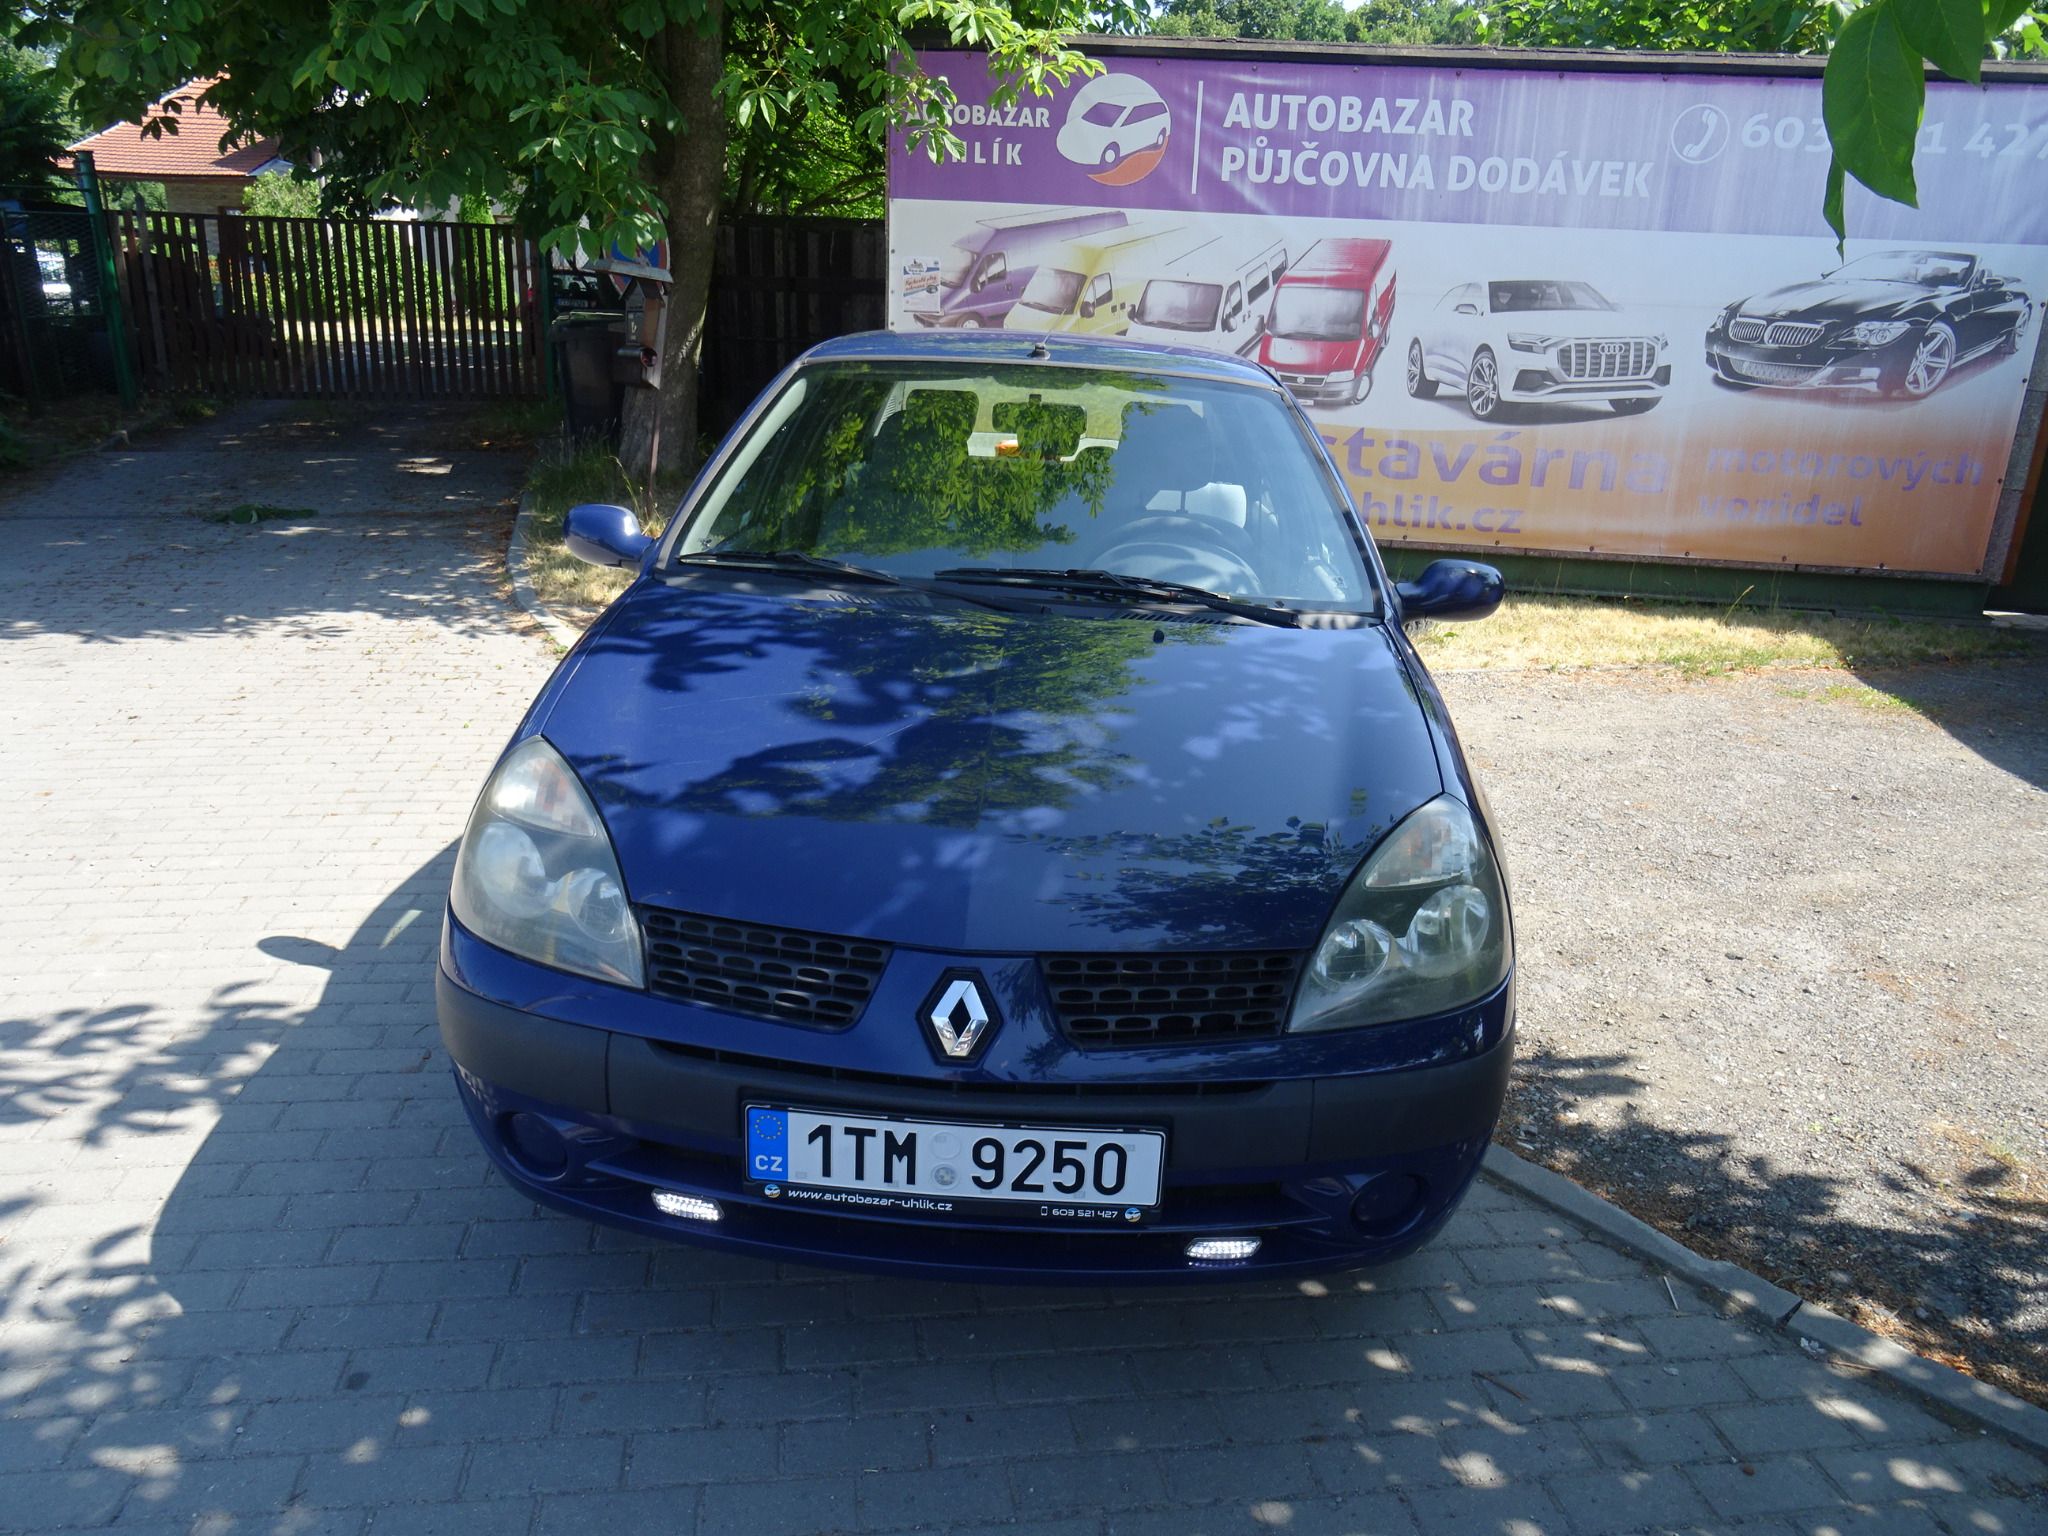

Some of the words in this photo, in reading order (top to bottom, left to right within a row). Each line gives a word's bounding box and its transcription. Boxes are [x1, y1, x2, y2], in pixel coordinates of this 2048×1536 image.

[1222, 92, 1474, 137] AUTOBAZAR
[1221, 135, 1436, 190] PŮJČOVNA
[1447, 150, 1655, 198] DODÁVEK
[1320, 426, 1668, 494] tavárna
[1705, 447, 1985, 491] motorových
[1697, 491, 1863, 527] vozidel
[755, 1154, 783, 1172] CZ
[807, 1124, 917, 1186] 1TM
[971, 1136, 1128, 1196] 9250
[788, 1189, 953, 1212] www.autobazar-uhlik.cz
[1052, 1208, 1075, 1217] 603
[1077, 1209, 1095, 1218] 521
[1097, 1209, 1118, 1219] 427
